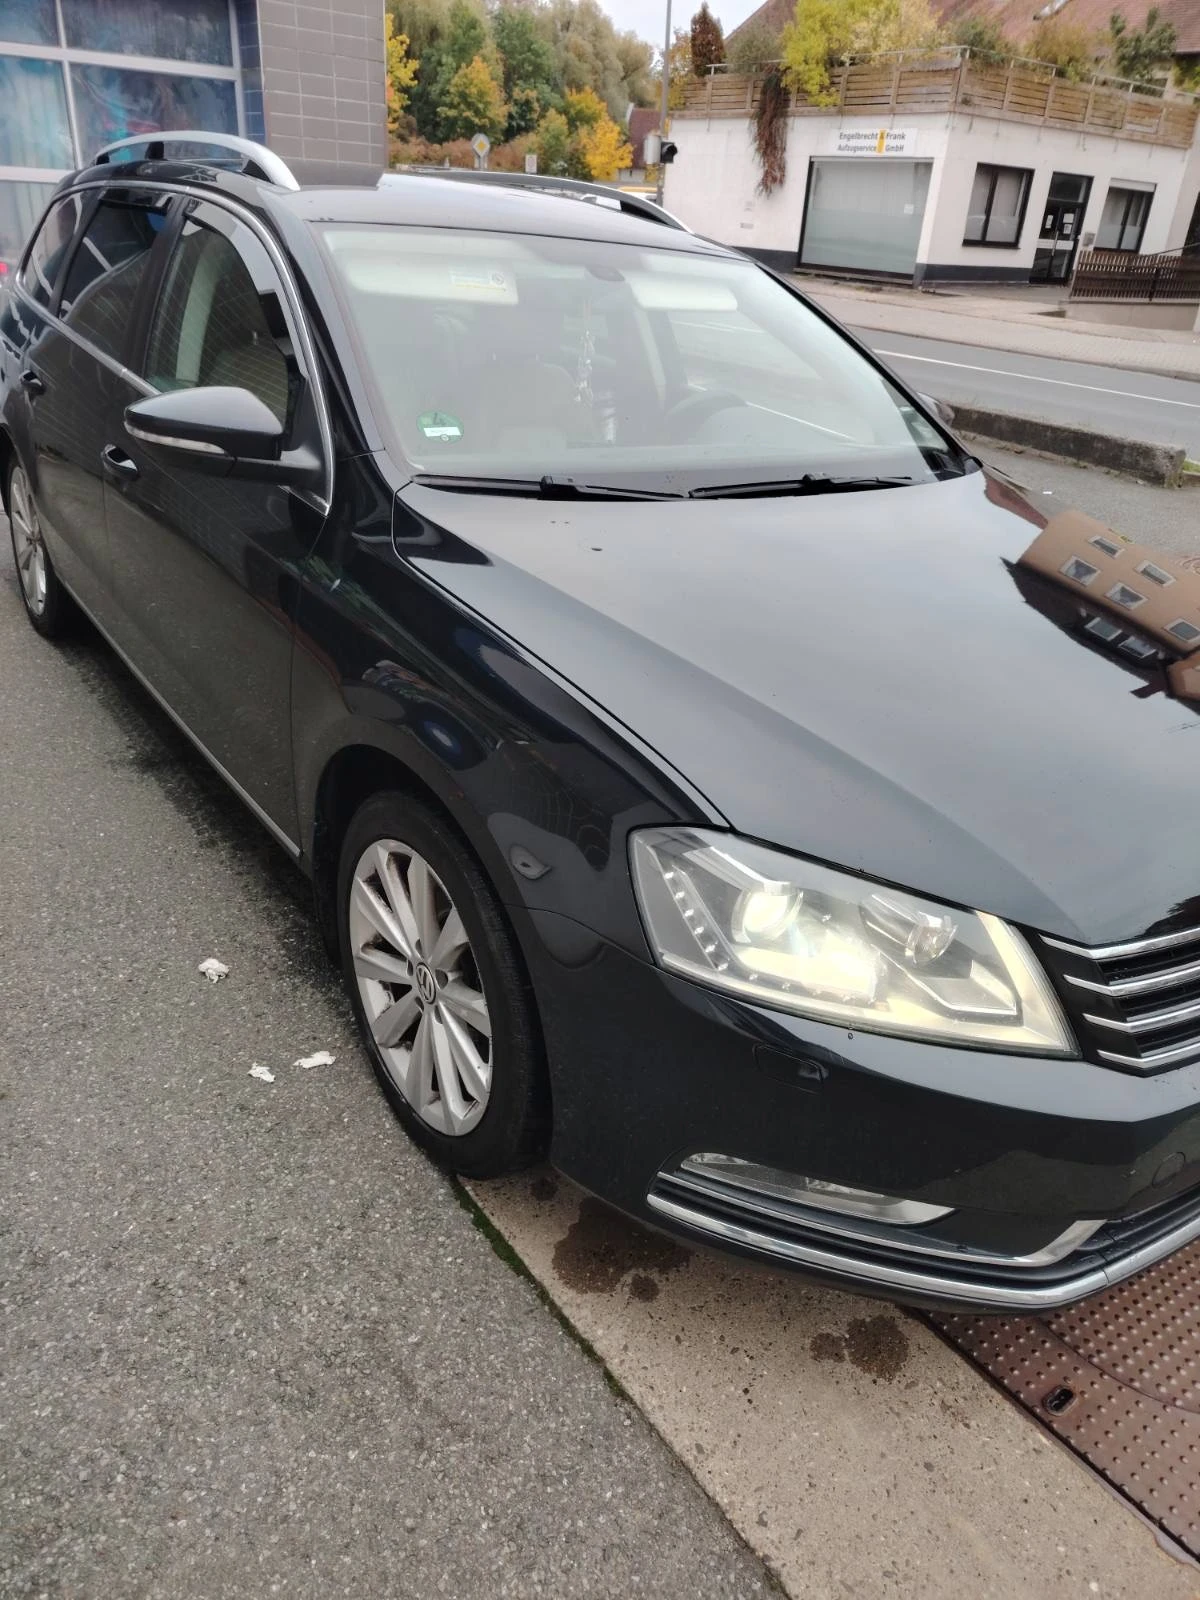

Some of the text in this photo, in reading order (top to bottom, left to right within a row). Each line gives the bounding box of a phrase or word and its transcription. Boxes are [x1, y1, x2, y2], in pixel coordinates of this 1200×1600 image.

[839, 131, 879, 141] Engelbrecht
[886, 132, 906, 140] Frank
[885, 144, 904, 152] GmbH
